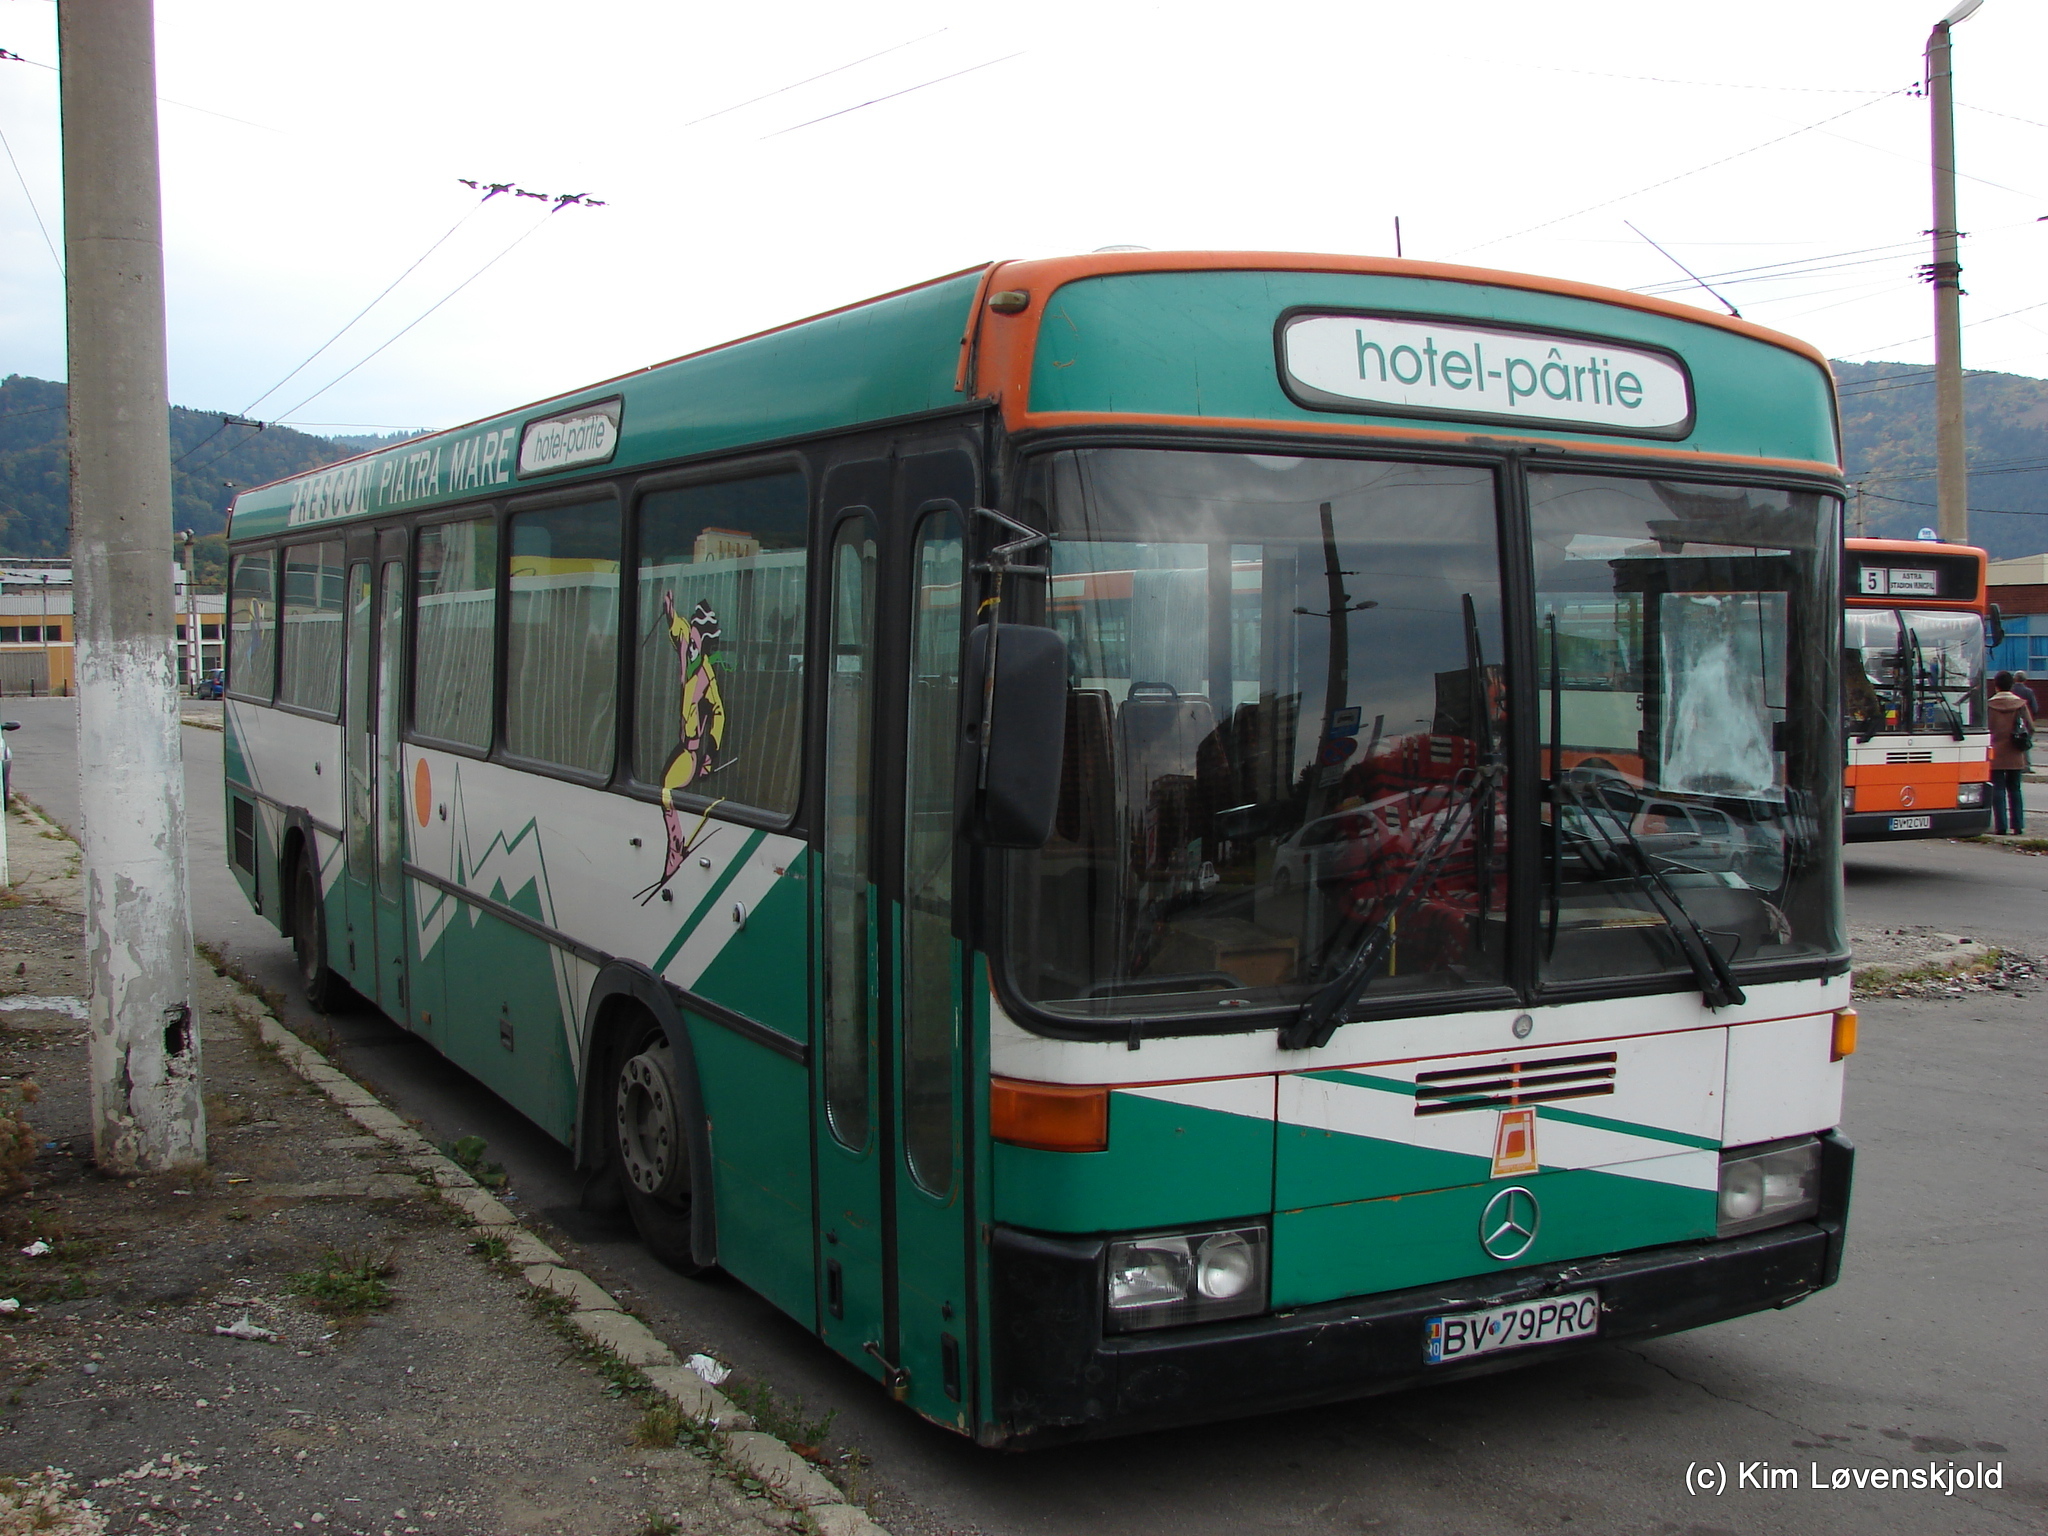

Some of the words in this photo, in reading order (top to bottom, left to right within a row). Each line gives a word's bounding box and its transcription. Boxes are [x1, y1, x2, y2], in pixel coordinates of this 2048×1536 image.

[1355, 328, 1643, 409] hotel-pârtie
[378, 446, 441, 506] PIATRA
[449, 427, 516, 493] MARE
[1868, 572, 1877, 590] 5
[1443, 1316, 1490, 1355] BV
[1499, 1296, 1596, 1344] 79PRC
